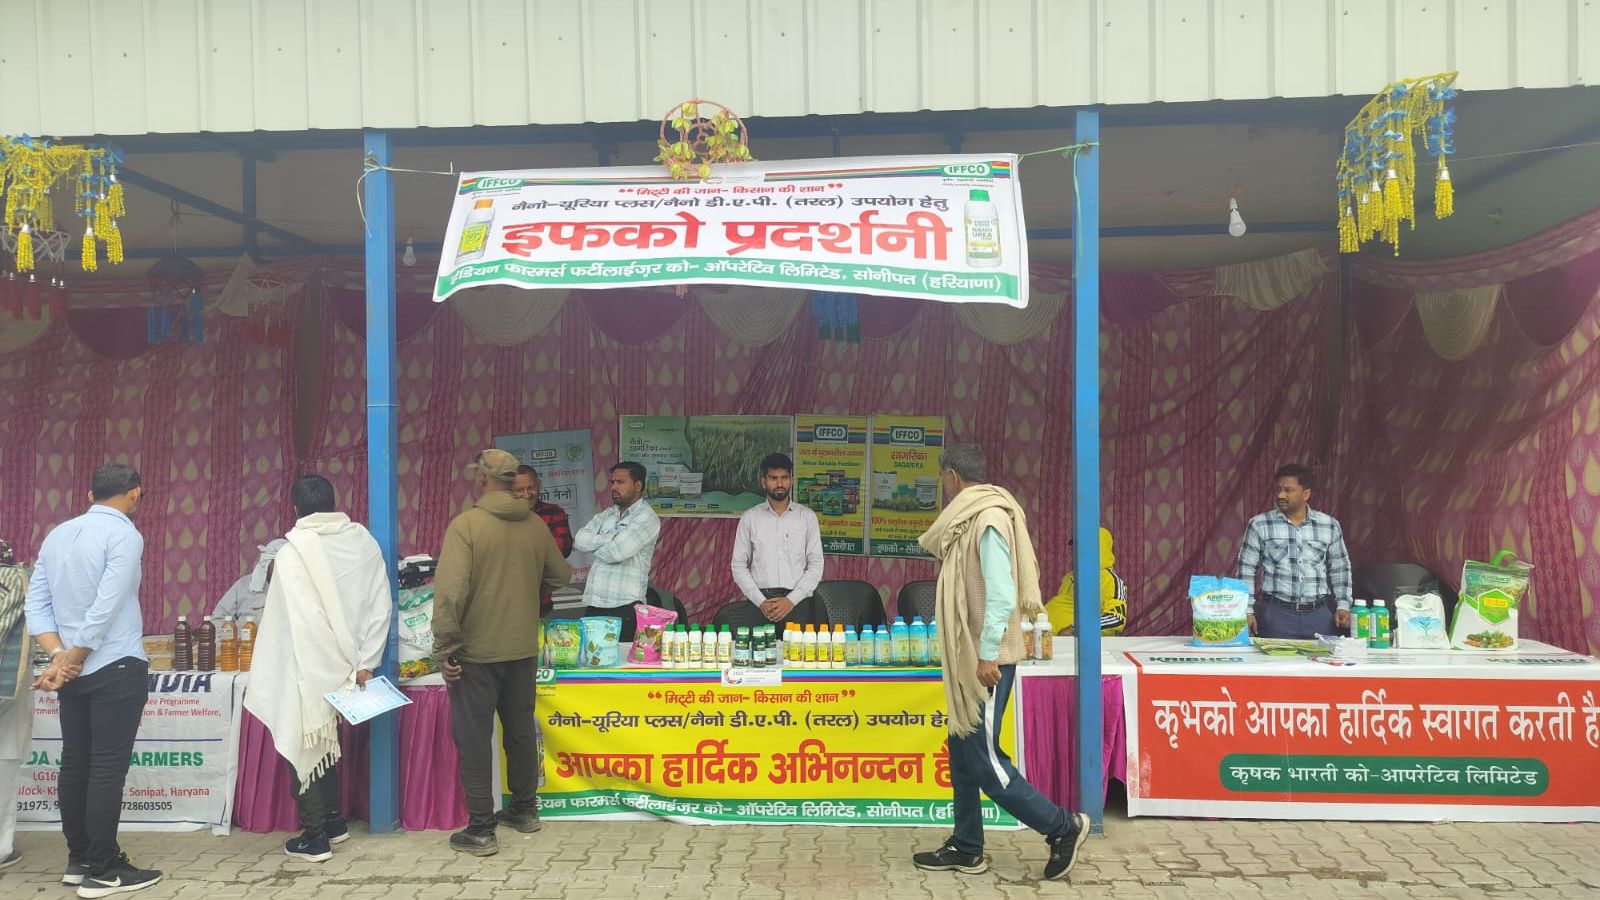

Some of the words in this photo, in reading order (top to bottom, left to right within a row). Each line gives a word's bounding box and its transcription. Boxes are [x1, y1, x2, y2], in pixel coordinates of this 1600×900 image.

[950, 165, 985, 174] IFFCO
[481, 179, 517, 188] IFFCO
[674, 187, 690, 195] की
[732, 183, 775, 194] किसान
[779, 182, 796, 193] की
[614, 197, 699, 209] प्लस/नैनो
[705, 195, 778, 208] डी.ए.पी.
[786, 194, 844, 209] (तरल)
[852, 195, 914, 208] उपयोग
[920, 195, 950, 212] हेतु
[502, 211, 706, 257] इफको
[722, 210, 952, 261] प्रदर्शनी
[504, 259, 566, 279] फारमर्स
[704, 258, 774, 275] ऑपरेटिव
[852, 266, 916, 286] सोनीपत
[922, 272, 1001, 292] (हरियाणा)
[818, 428, 843, 437] IFFCO
[895, 430, 920, 440] IFFCO
[160, 698, 200, 706] Programme
[698, 690, 714, 704] की
[754, 690, 792, 704] किसान
[796, 690, 811, 704] की
[164, 708, 190, 716] Farmer
[1151, 686, 1238, 749] कृभको
[1245, 700, 1330, 738] आपका
[1336, 688, 1414, 744] हार्दिक
[1419, 704, 1500, 742] स्वागत
[1506, 691, 1576, 742] करती
[644, 710, 724, 729] प्लस/नैनो
[730, 710, 797, 727] डी.ए.पी.
[804, 710, 860, 730] (तरल)
[866, 710, 925, 727] उपयोग
[130, 752, 204, 767] ARMERS
[556, 751, 654, 784] आपका
[662, 738, 760, 788] हार्दिक
[768, 738, 926, 785] अभिनन्दन
[1229, 765, 1282, 785] कृषक
[1288, 763, 1339, 782] भारती
[1465, 764, 1538, 786] लिमिटेड
[170, 786, 210, 798] Haryana
[570, 792, 620, 810] फारमर्स
[736, 798, 797, 817] ऑपरेटिव
[866, 801, 924, 818] सोनीपत
